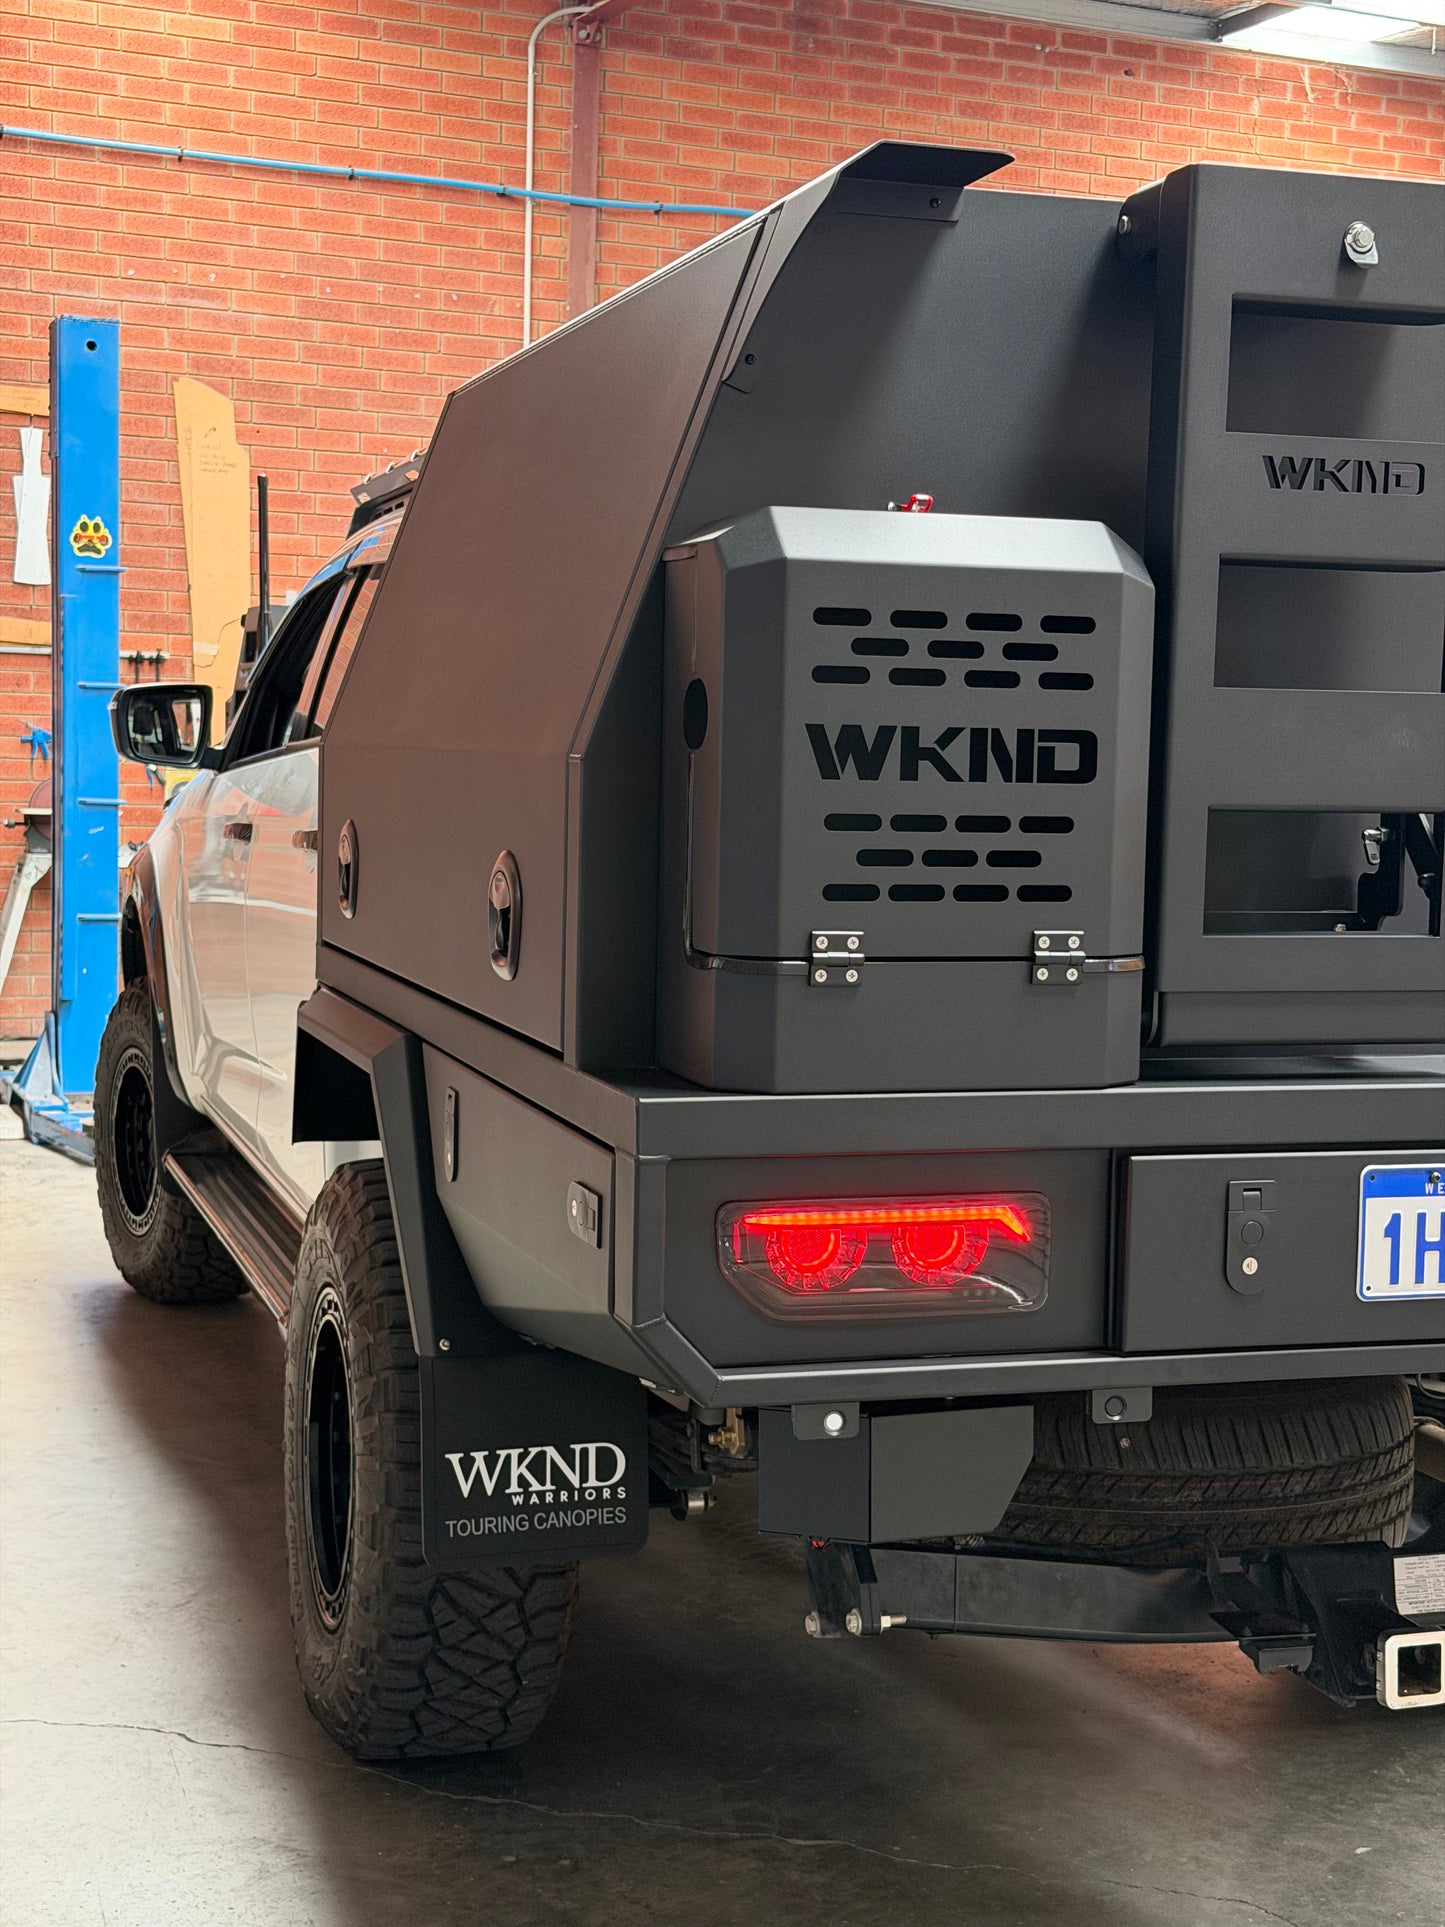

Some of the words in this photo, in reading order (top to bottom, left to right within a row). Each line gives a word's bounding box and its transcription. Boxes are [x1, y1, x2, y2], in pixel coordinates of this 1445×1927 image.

[1261, 454, 1426, 497] WKND
[804, 723, 1098, 785] WKND
[1383, 1211, 1445, 1286] 1H
[444, 1442, 627, 1499] WKND
[511, 1486, 627, 1506] WARRIORS
[445, 1513, 530, 1538] TOURING
[533, 1506, 627, 1530] CANOPIES
